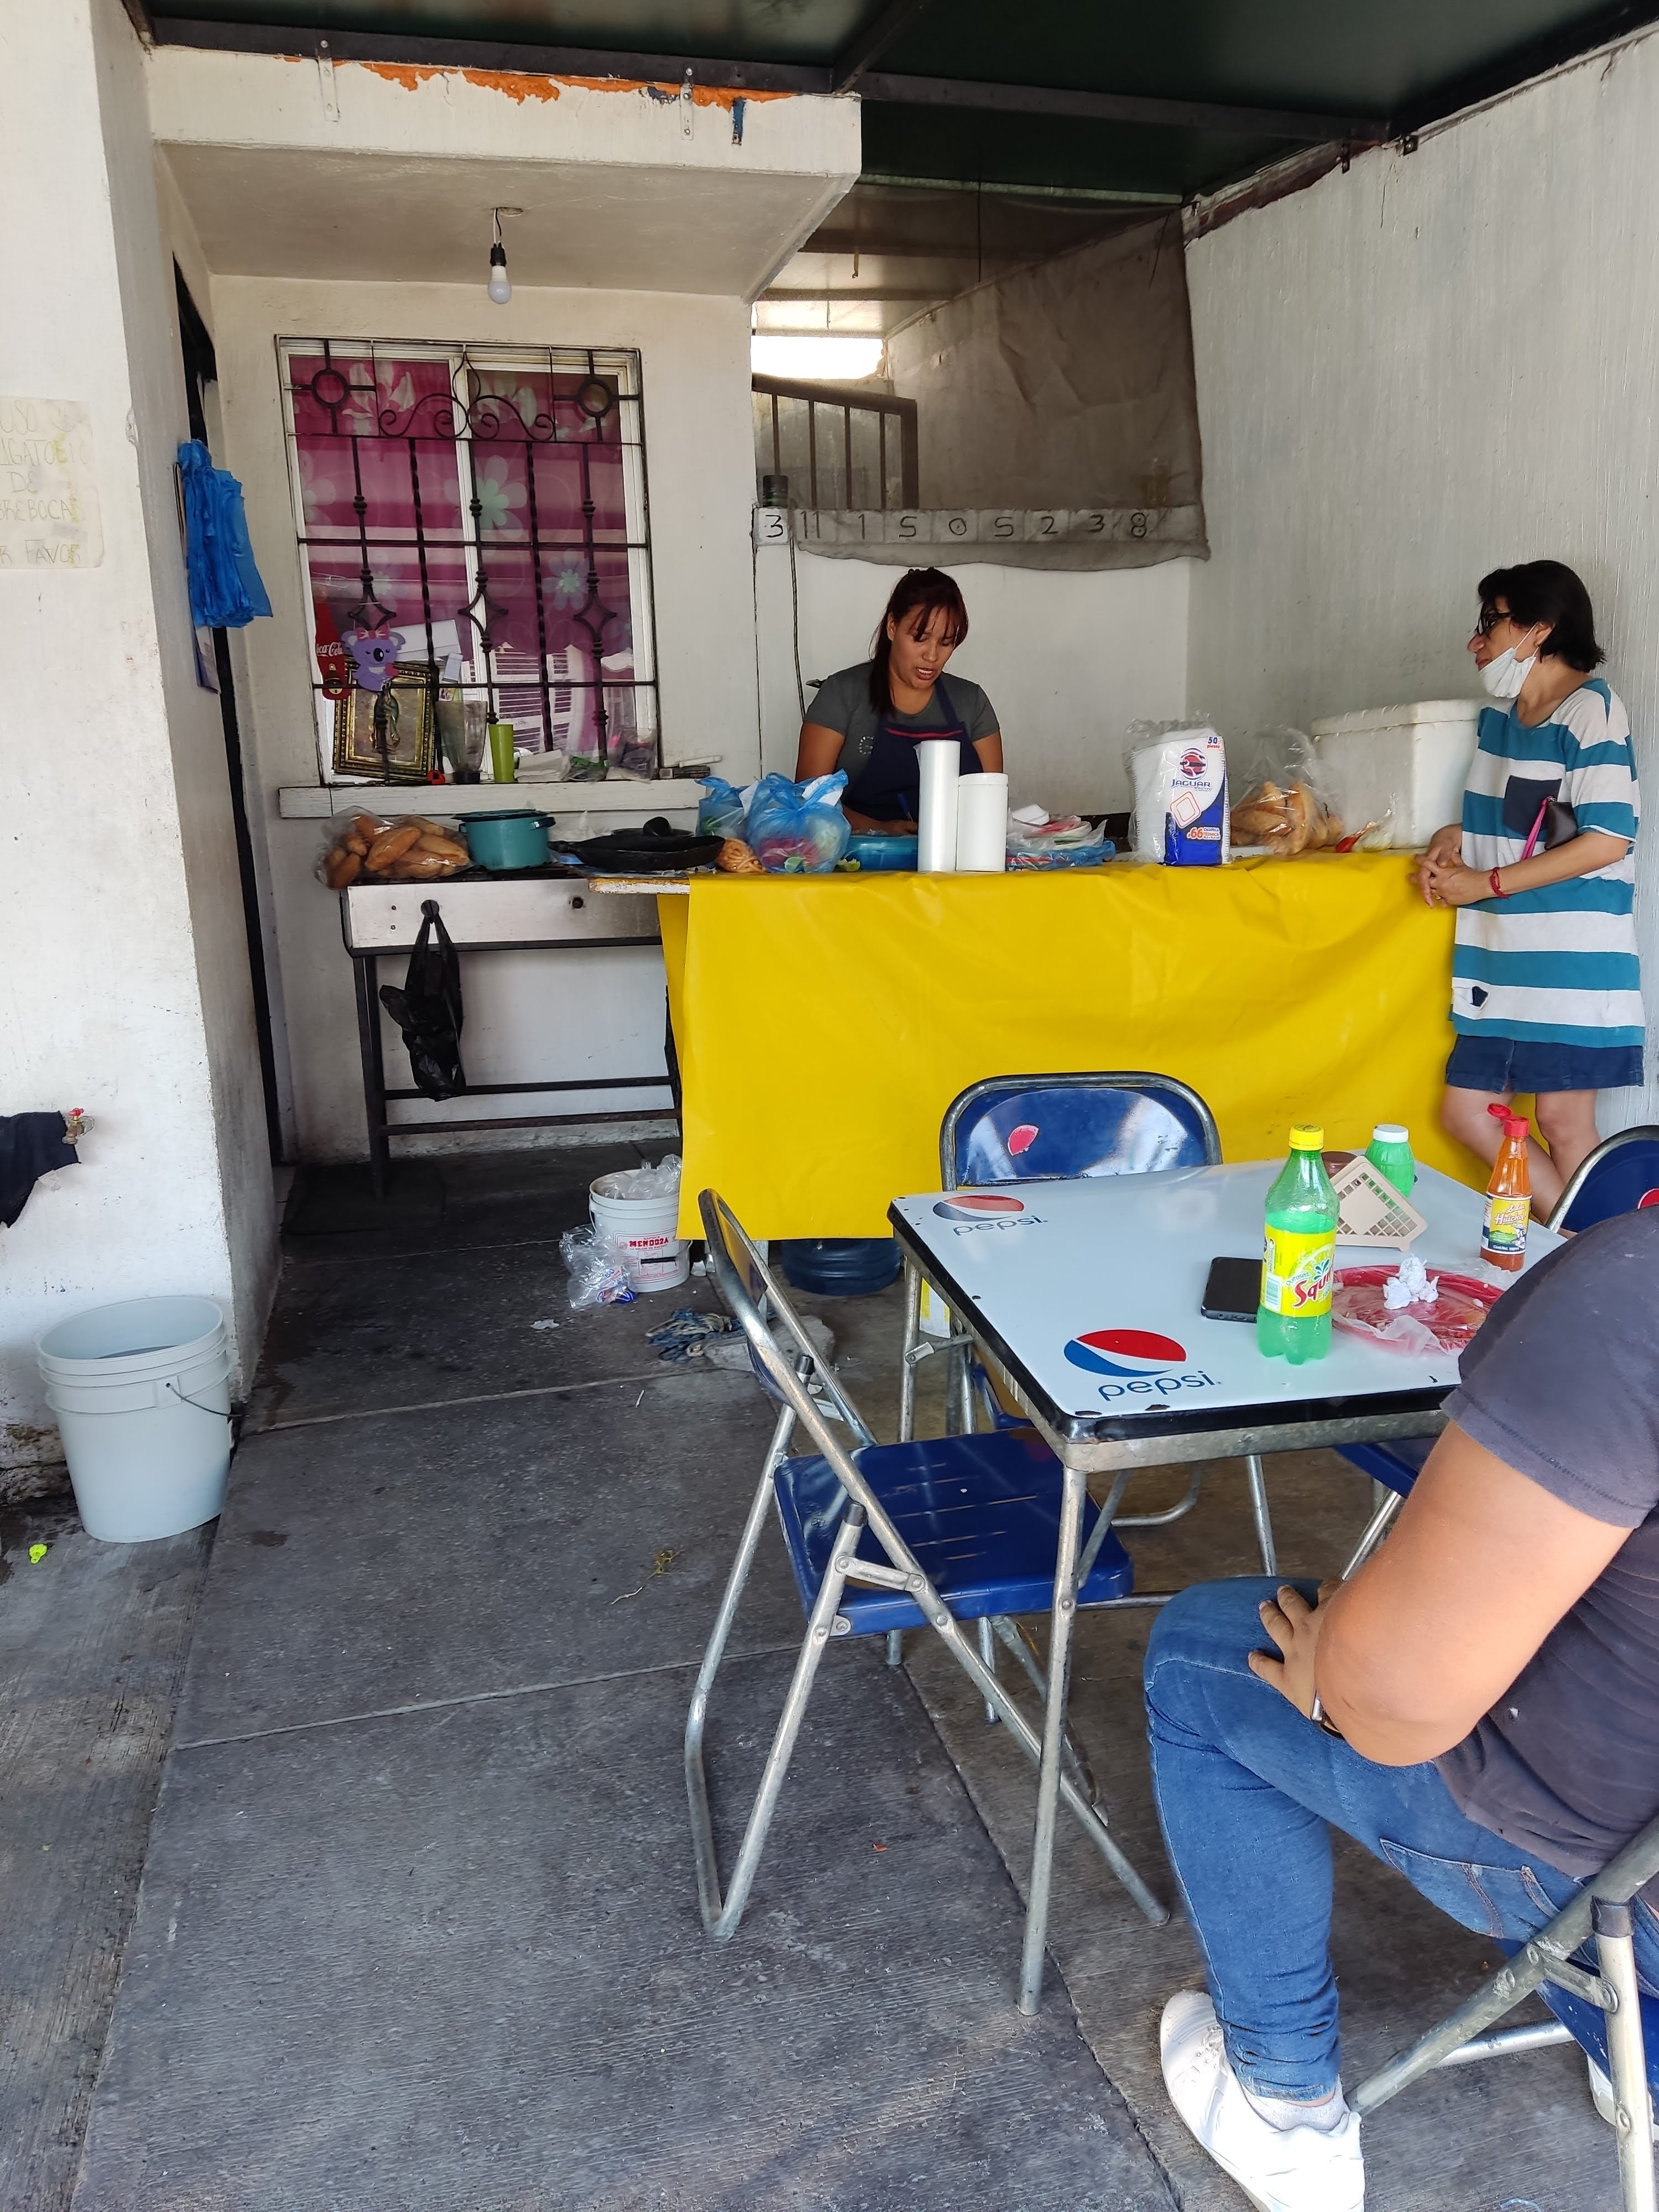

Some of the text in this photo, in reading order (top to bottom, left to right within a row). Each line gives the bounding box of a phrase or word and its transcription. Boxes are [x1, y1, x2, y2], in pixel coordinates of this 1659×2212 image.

[8, 471, 38, 494] DE
[1207, 736, 1218, 744] 50
[1171, 779, 1211, 787] JAGUAR
[953, 1215, 1044, 1236] pepsi
[629, 1237, 669, 1248] MENDOZA
[1098, 1370, 1215, 1402] pepsi
